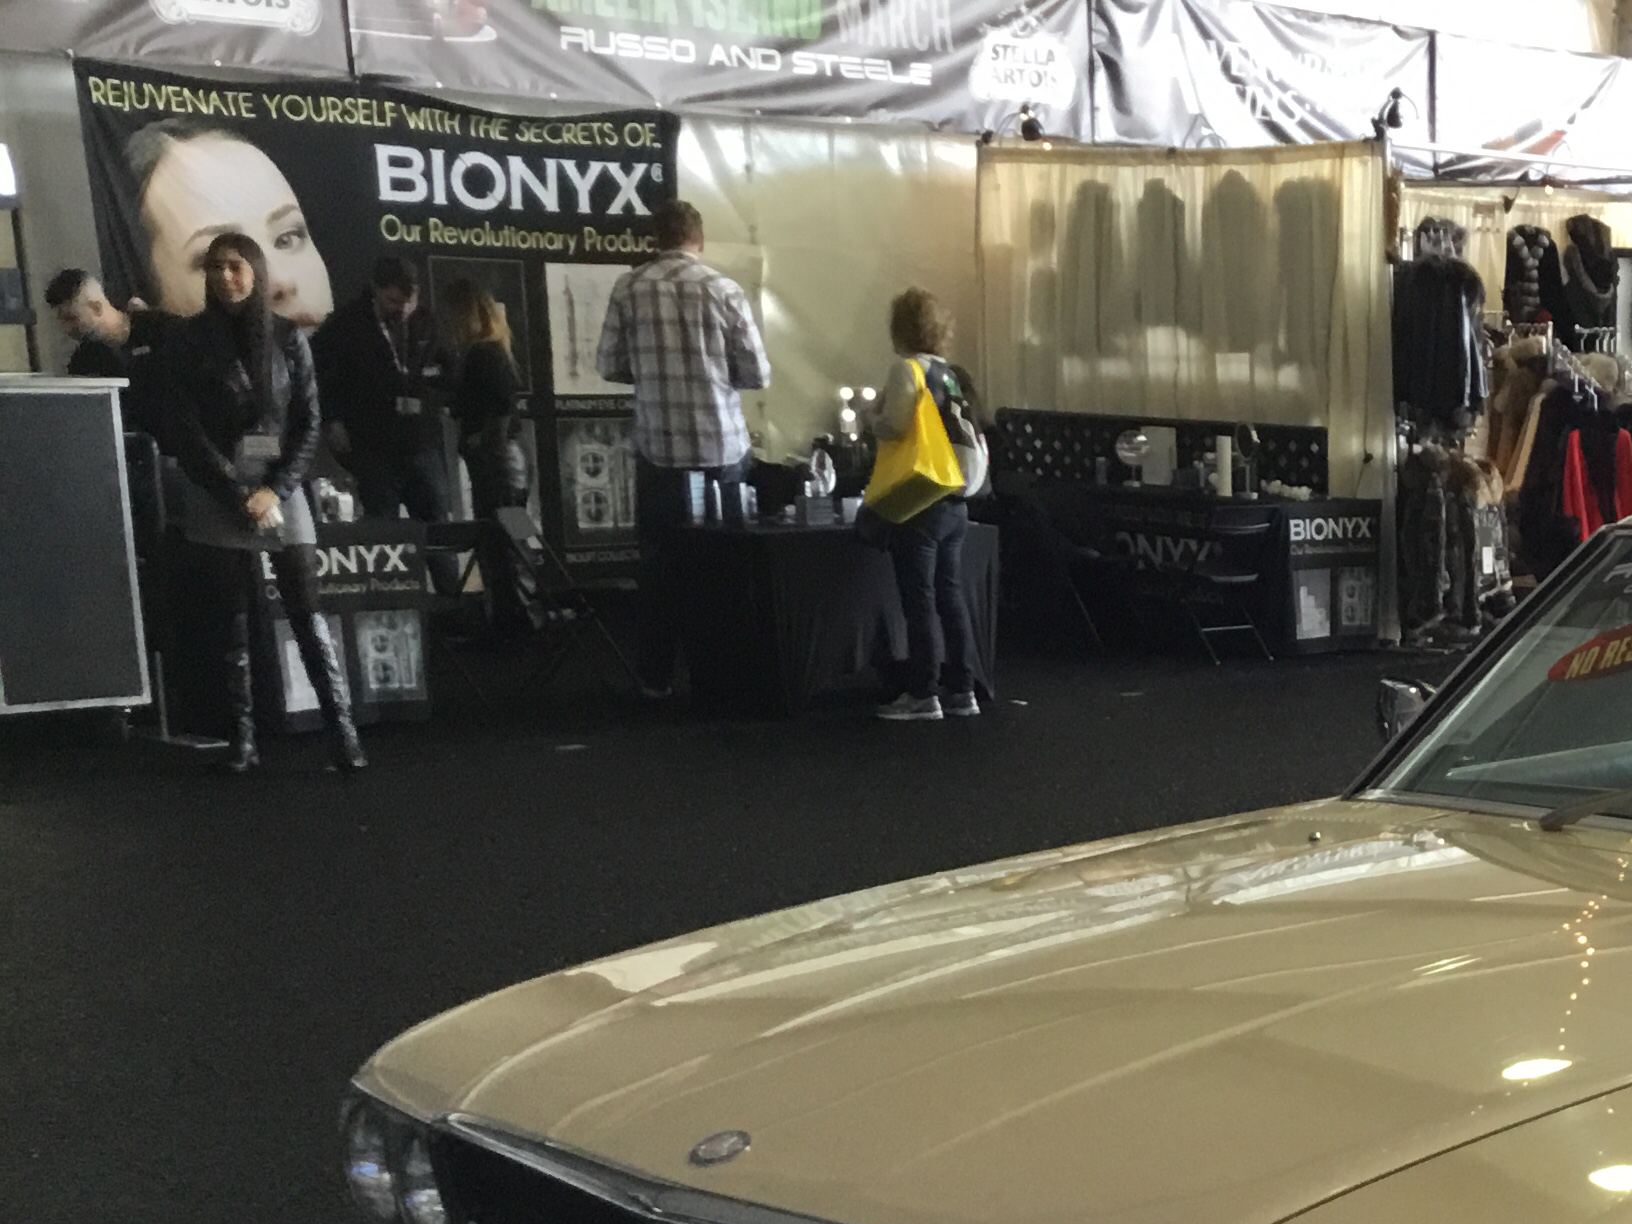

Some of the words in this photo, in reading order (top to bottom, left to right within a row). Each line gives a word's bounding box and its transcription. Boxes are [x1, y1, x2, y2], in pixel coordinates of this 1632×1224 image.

[560, 26, 695, 63] RUSSO
[708, 44, 781, 71] AND
[792, 52, 933, 85] STEELE
[990, 43, 1056, 64] STELLA
[88, 76, 257, 119] REJUVENATE
[263, 93, 397, 128] YOURSELF
[401, 103, 461, 135] WITH
[469, 114, 509, 141] THE
[515, 121, 618, 145] SECRETS
[380, 213, 421, 243] Our
[429, 217, 576, 255] Revolutionary
[584, 226, 659, 253] Produc
[1289, 516, 1372, 541] BIONYX
[1115, 531, 1210, 571] ONYX
[1564, 645, 1601, 680] NO
